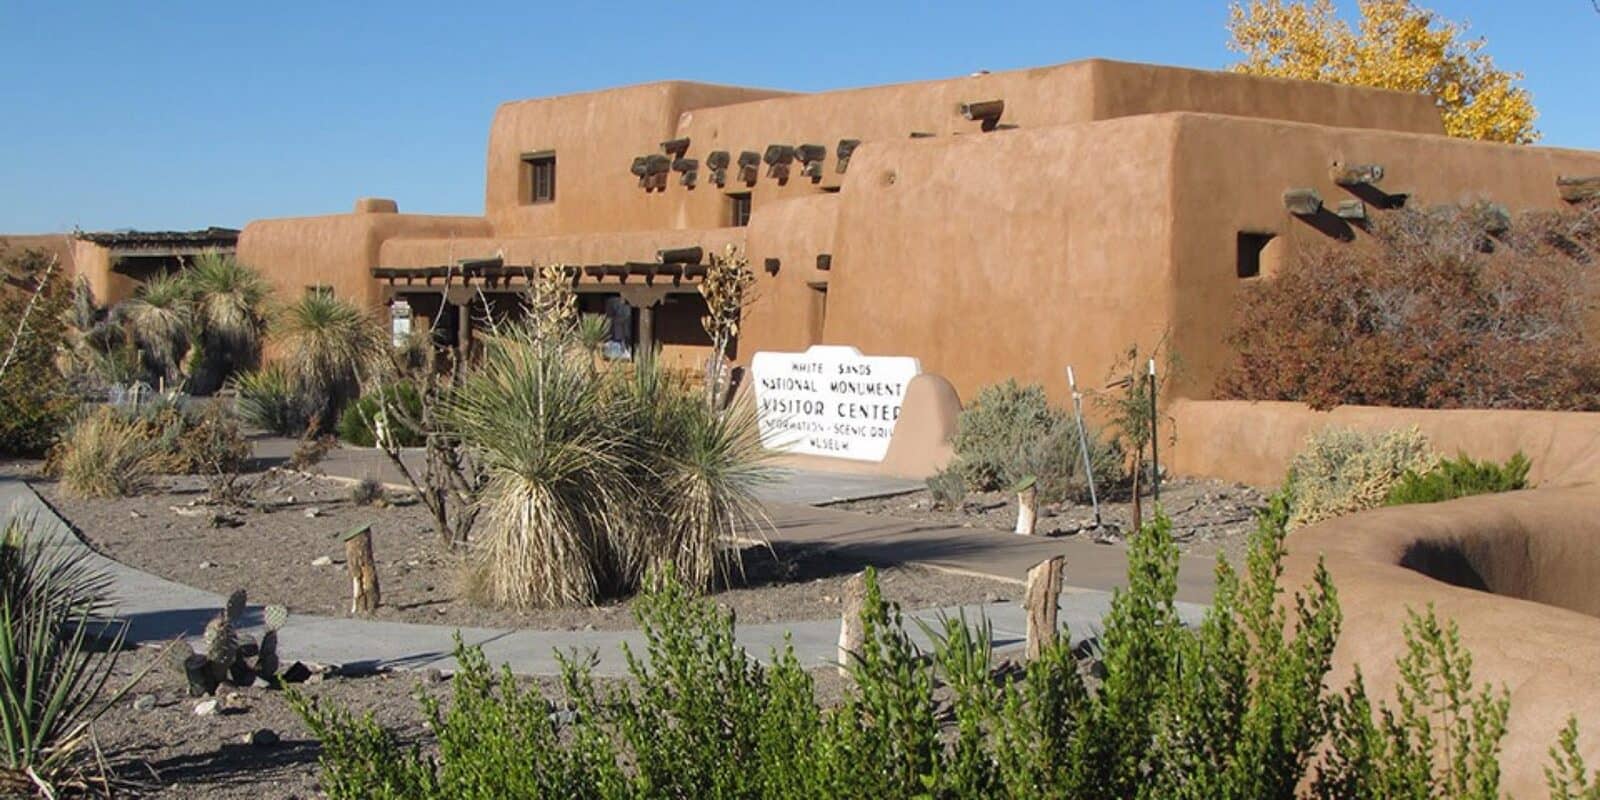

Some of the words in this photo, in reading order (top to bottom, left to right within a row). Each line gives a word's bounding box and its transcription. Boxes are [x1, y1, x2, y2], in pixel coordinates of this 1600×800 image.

[791, 362, 824, 374] WHITE
[838, 363, 872, 376] SANDS
[762, 377, 818, 393] NATIONAL
[830, 380, 901, 397] MONUMENT
[763, 398, 824, 416] VISITOR
[837, 403, 901, 420] CENTER
[833, 423, 866, 437] SCENIC
[810, 437, 849, 451] MUSEUM
